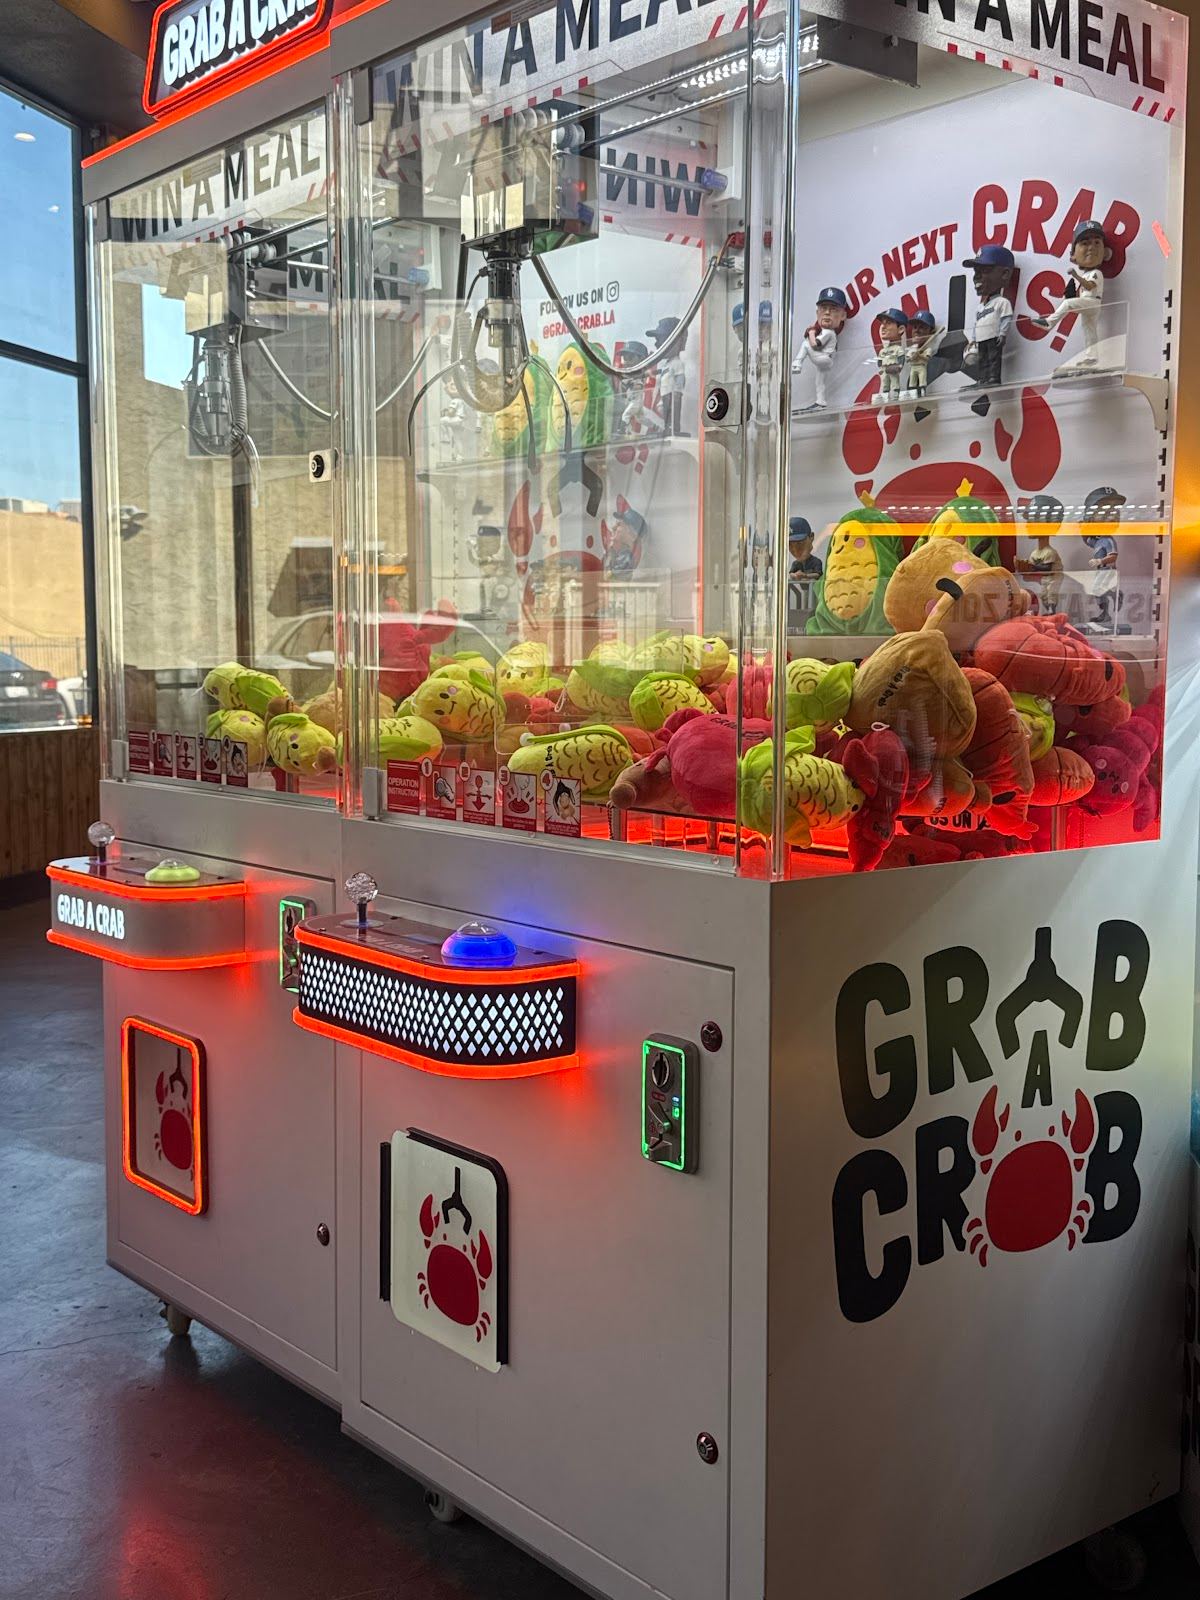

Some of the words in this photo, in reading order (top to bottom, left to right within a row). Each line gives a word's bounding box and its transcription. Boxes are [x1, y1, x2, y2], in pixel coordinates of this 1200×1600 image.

[163, 0, 226, 86] GRAB
[228, 0, 246, 49] A
[500, 19, 538, 87] A
[1030, 0, 1165, 93] MEAL
[121, 175, 183, 243] WIN
[192, 175, 215, 222] A
[224, 117, 321, 209] MEAL
[881, 223, 958, 288] NEXT
[972, 180, 1140, 279] CRAB
[540, 294, 574, 316] FOLOW
[576, 291, 589, 307] US
[591, 287, 604, 304] ON
[542, 309, 616, 339] @GRACRAB.LA
[388, 776, 419, 789] OPERATION
[57, 893, 85, 928] GRAB
[86, 901, 95, 932] A
[96, 904, 125, 940] CRAB
[1021, 1030, 1053, 1109] A
